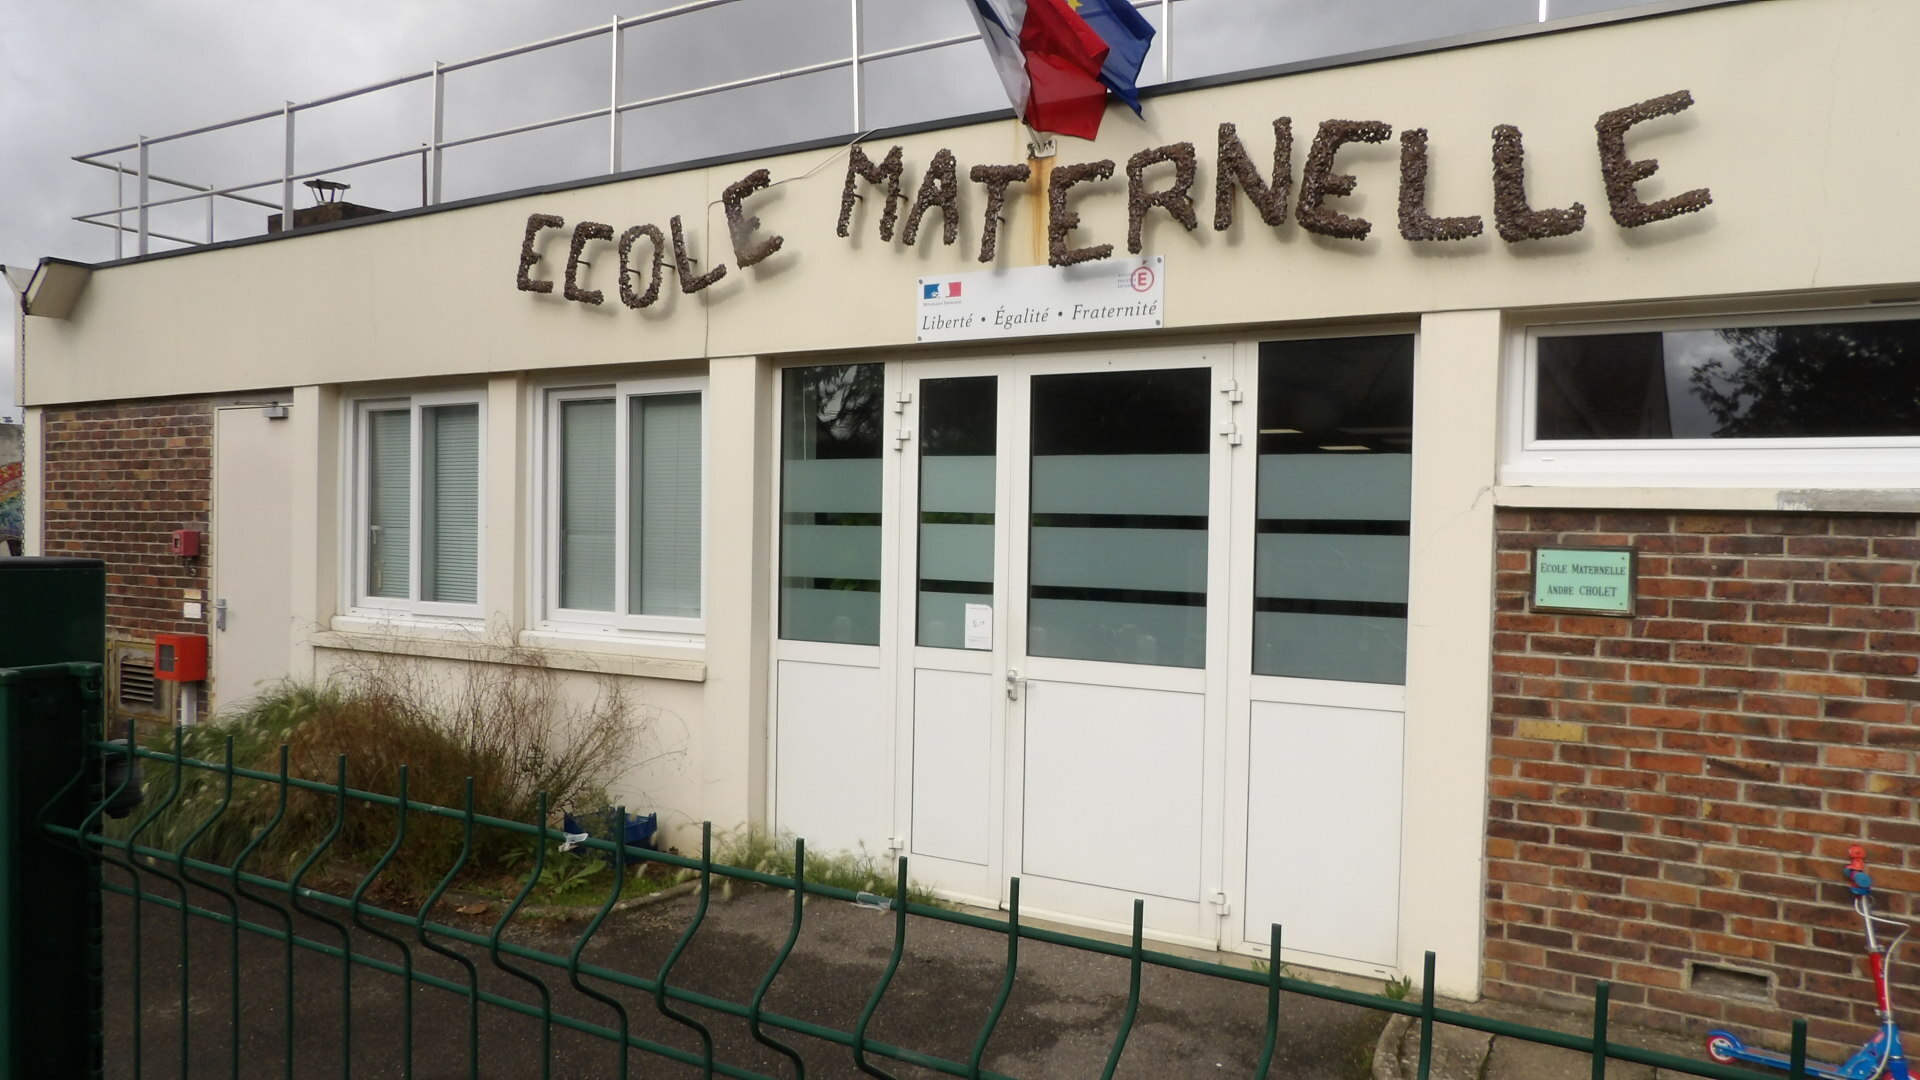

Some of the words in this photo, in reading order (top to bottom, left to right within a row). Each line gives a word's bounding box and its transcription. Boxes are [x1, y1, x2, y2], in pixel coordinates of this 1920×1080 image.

[516, 168, 784, 309] ECOLE
[836, 89, 1713, 267] MATERNELLE
[922, 313, 973, 331] Liberté
[994, 305, 1049, 330] Égalité
[1071, 299, 1158, 321] Fraternité
[1579, 585, 1617, 597] CHOLET
